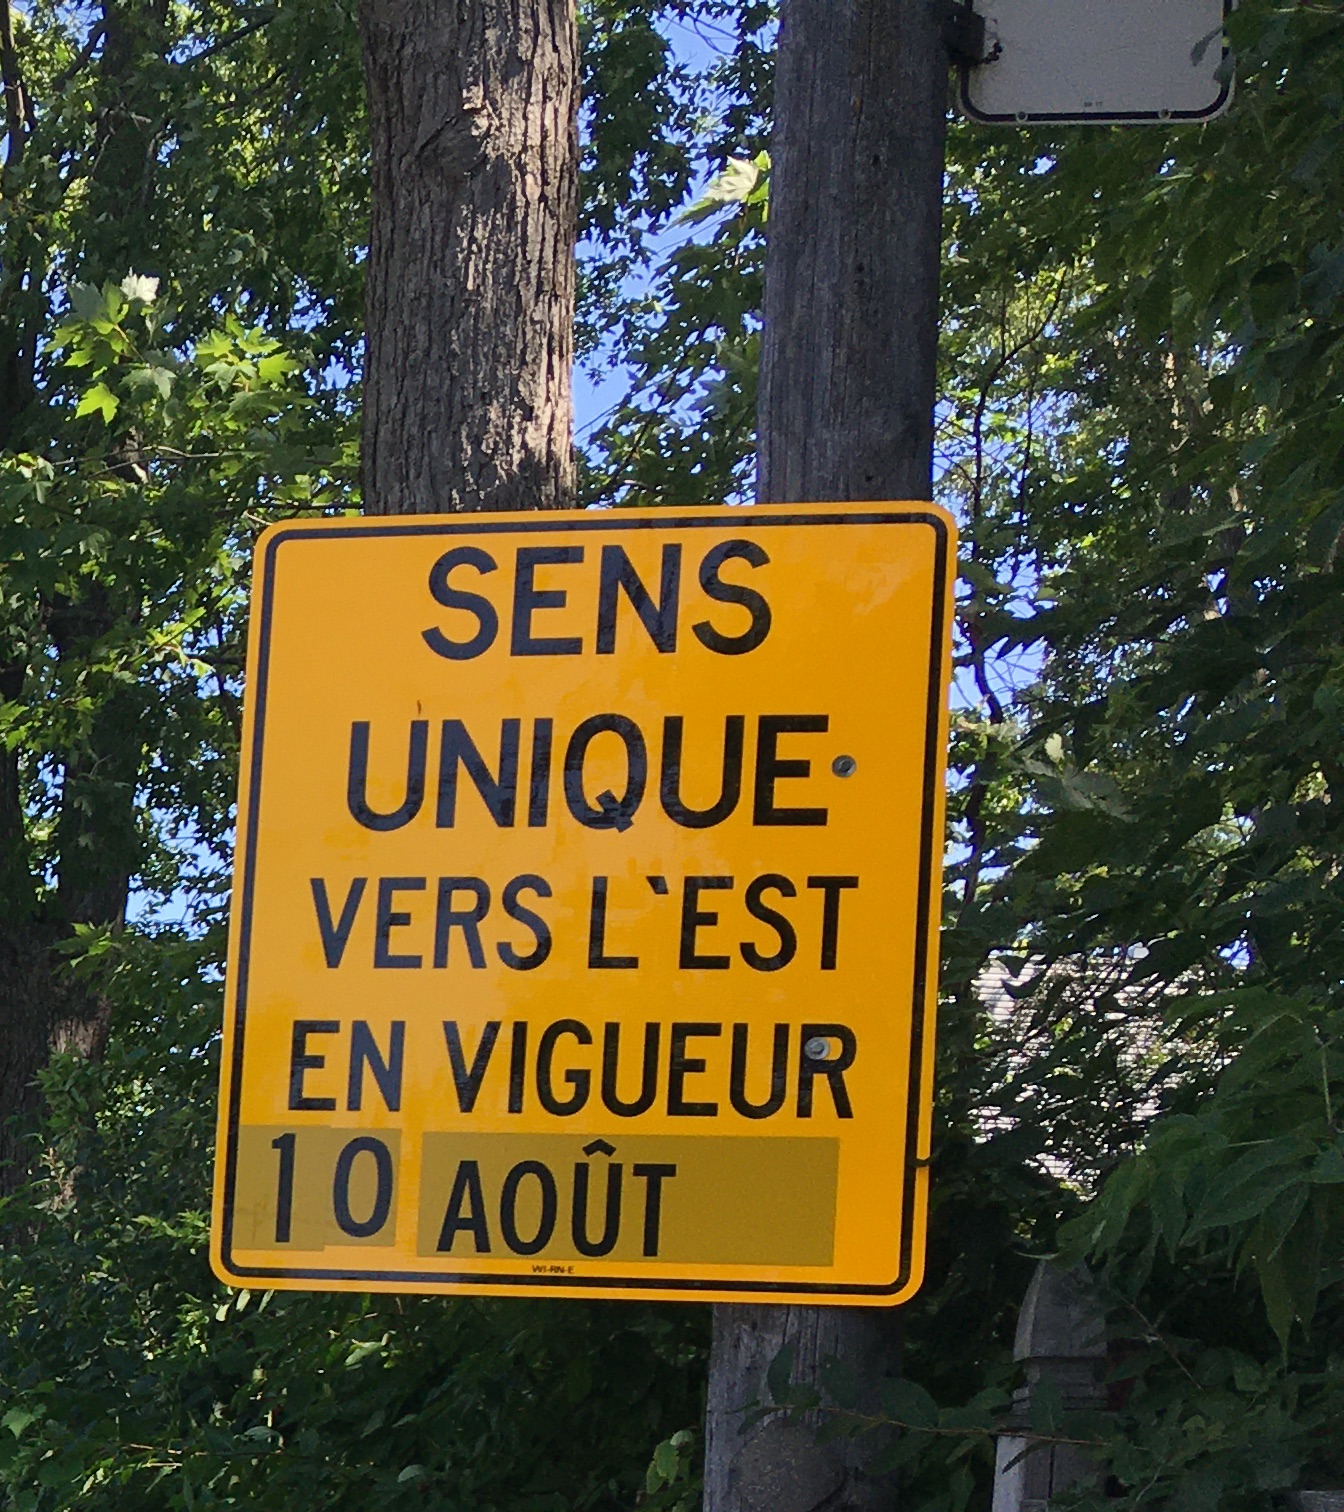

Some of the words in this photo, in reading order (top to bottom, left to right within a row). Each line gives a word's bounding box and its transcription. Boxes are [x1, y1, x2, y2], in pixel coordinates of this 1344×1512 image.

[421, 538, 773, 661] SENS
[347, 713, 829, 833] UNIQUE
[310, 874, 553, 971] VERS
[288, 1020, 405, 1113] EN
[443, 1018, 857, 1120] VIGUEUR
[271, 1132, 395, 1243] 10
[436, 1138, 678, 1258] AOÛT
